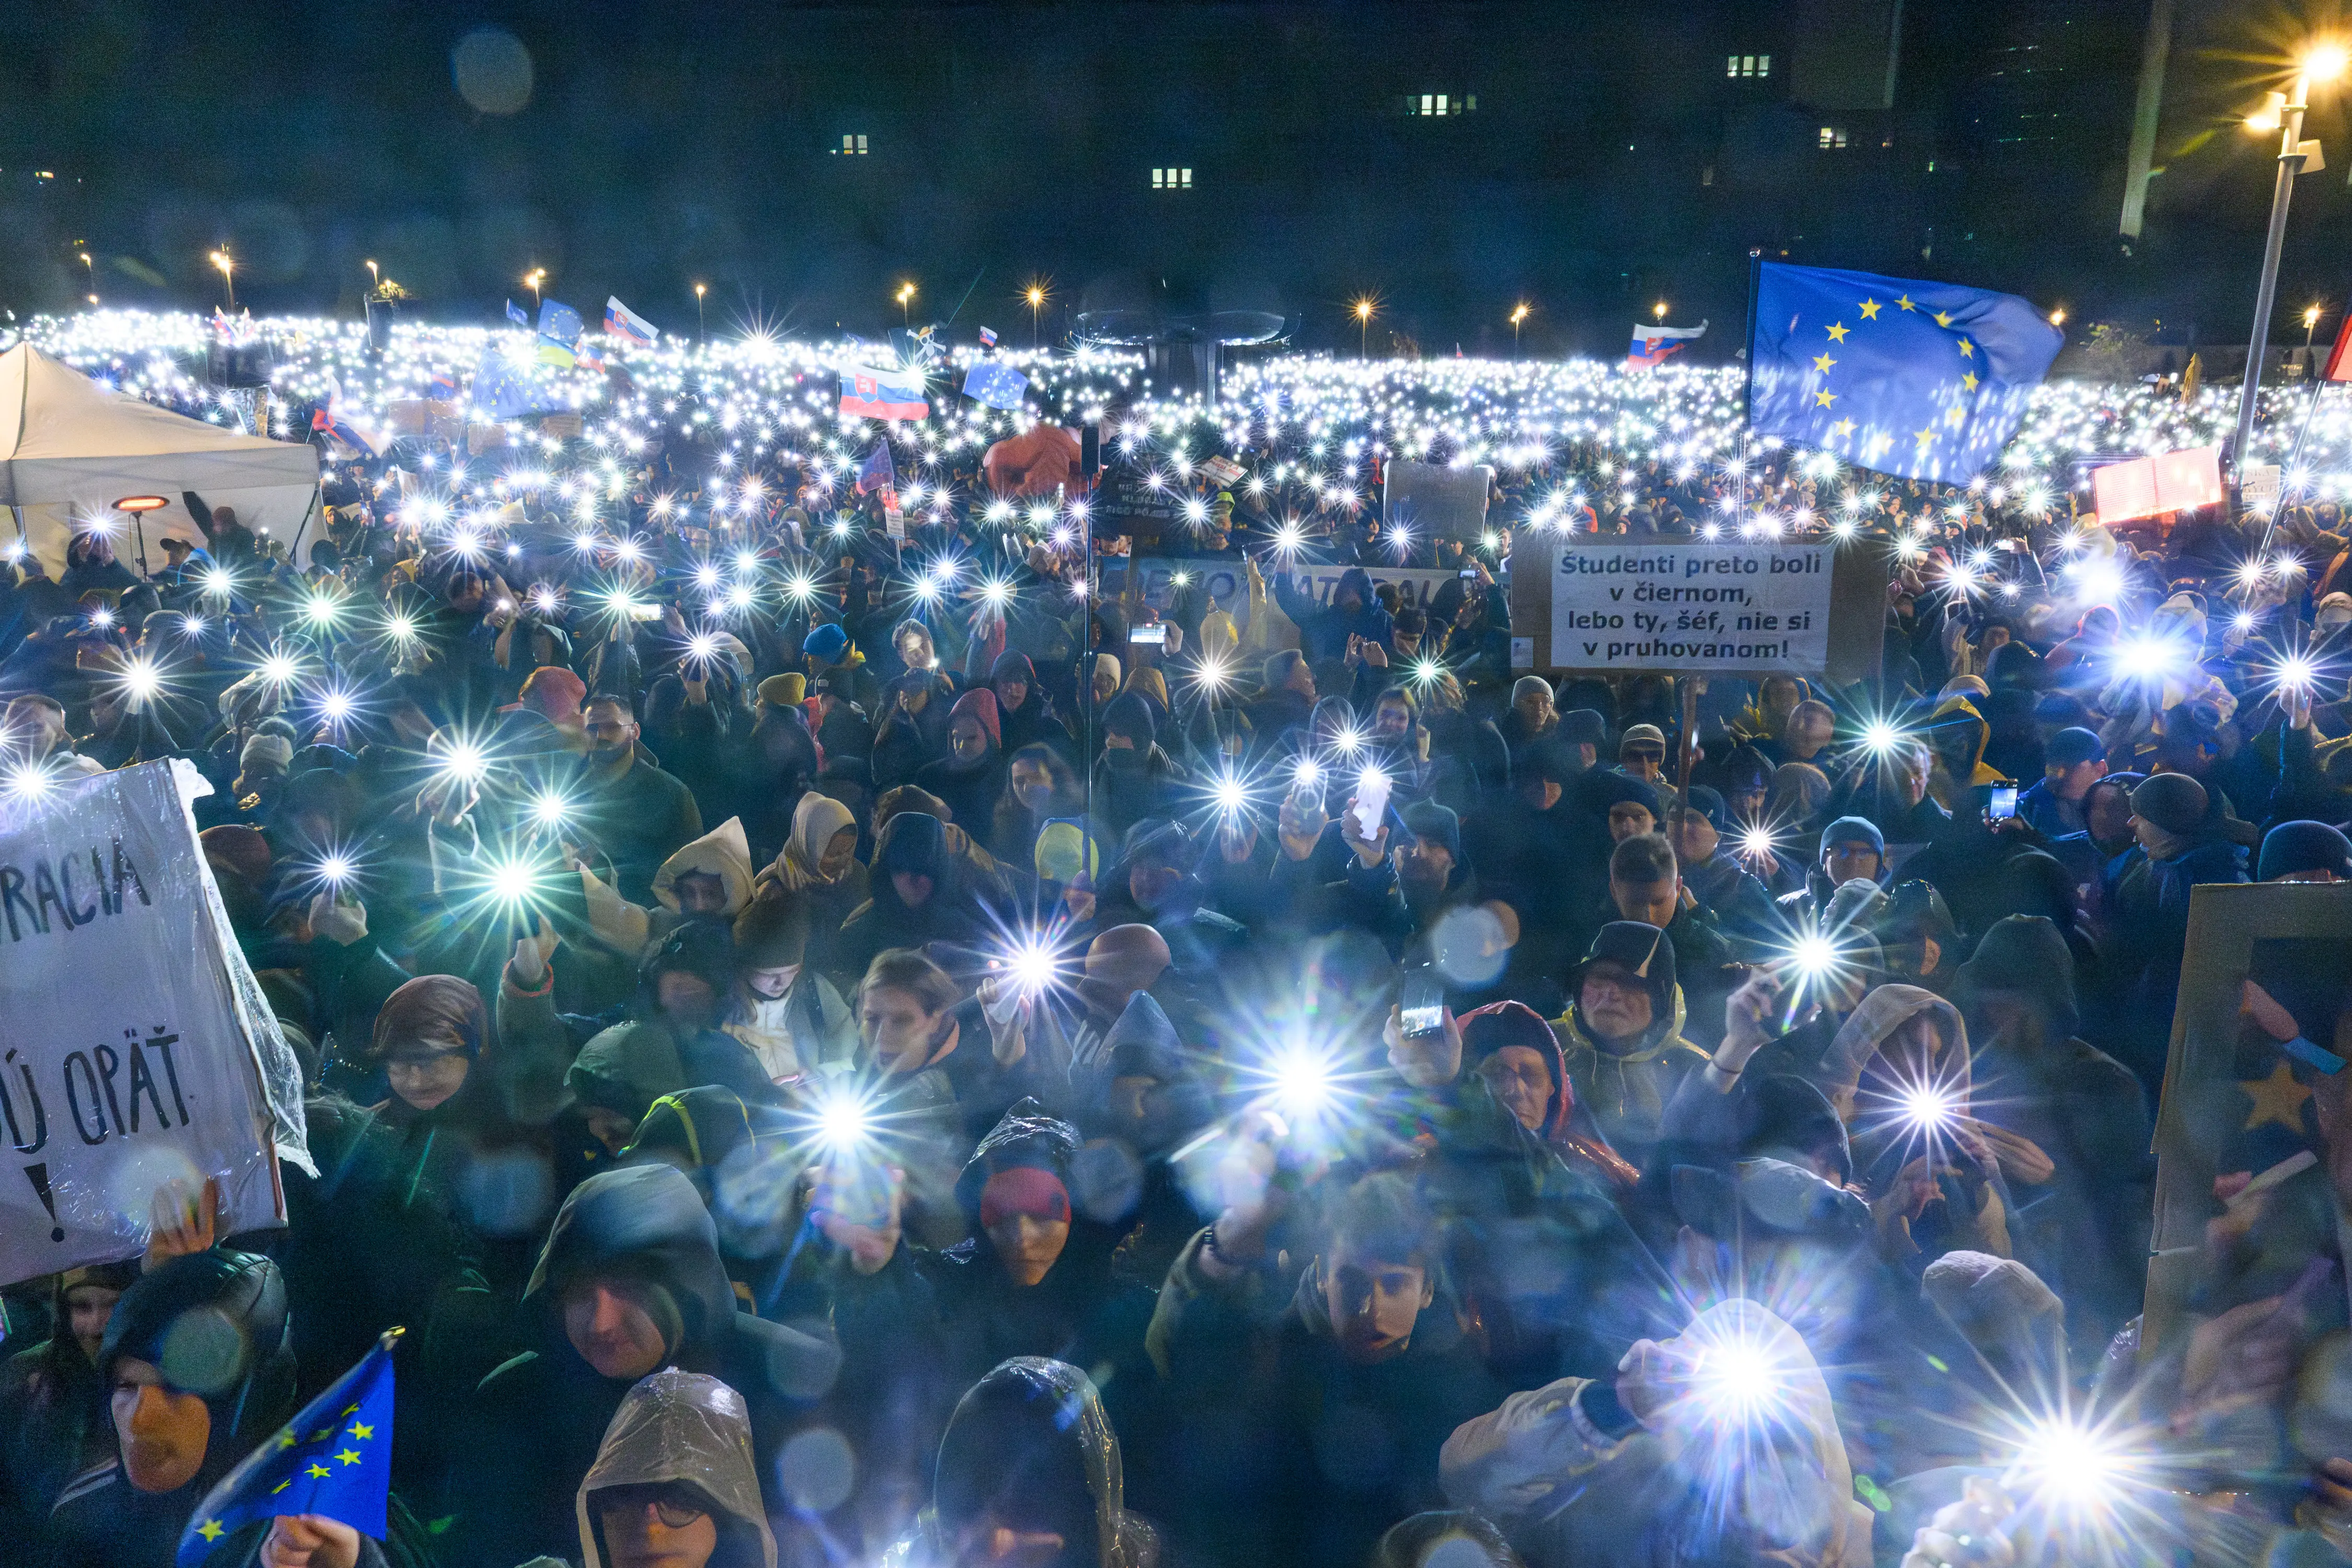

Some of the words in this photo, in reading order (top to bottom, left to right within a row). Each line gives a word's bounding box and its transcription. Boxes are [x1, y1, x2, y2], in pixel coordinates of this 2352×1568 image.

[1561, 550, 1675, 574] Študenti
[1685, 557, 1759, 578] preto
[1770, 554, 1821, 574] boli
[1609, 587, 1624, 601] v
[1633, 581, 1753, 606] čiernom,
[1568, 610, 1624, 629] lebo
[1633, 612, 1667, 633] ty,
[1677, 609, 1725, 633] šéf,
[1737, 612, 1778, 630] nie
[1788, 610, 1811, 630] si
[1583, 641, 1598, 656] v
[1607, 639, 1789, 660] pruhovanom!
[0, 836, 152, 942] RACIA
[0, 1047, 48, 1154] Ú
[63, 1025, 190, 1145] OPÄŤ
[23, 1162, 65, 1242] !
